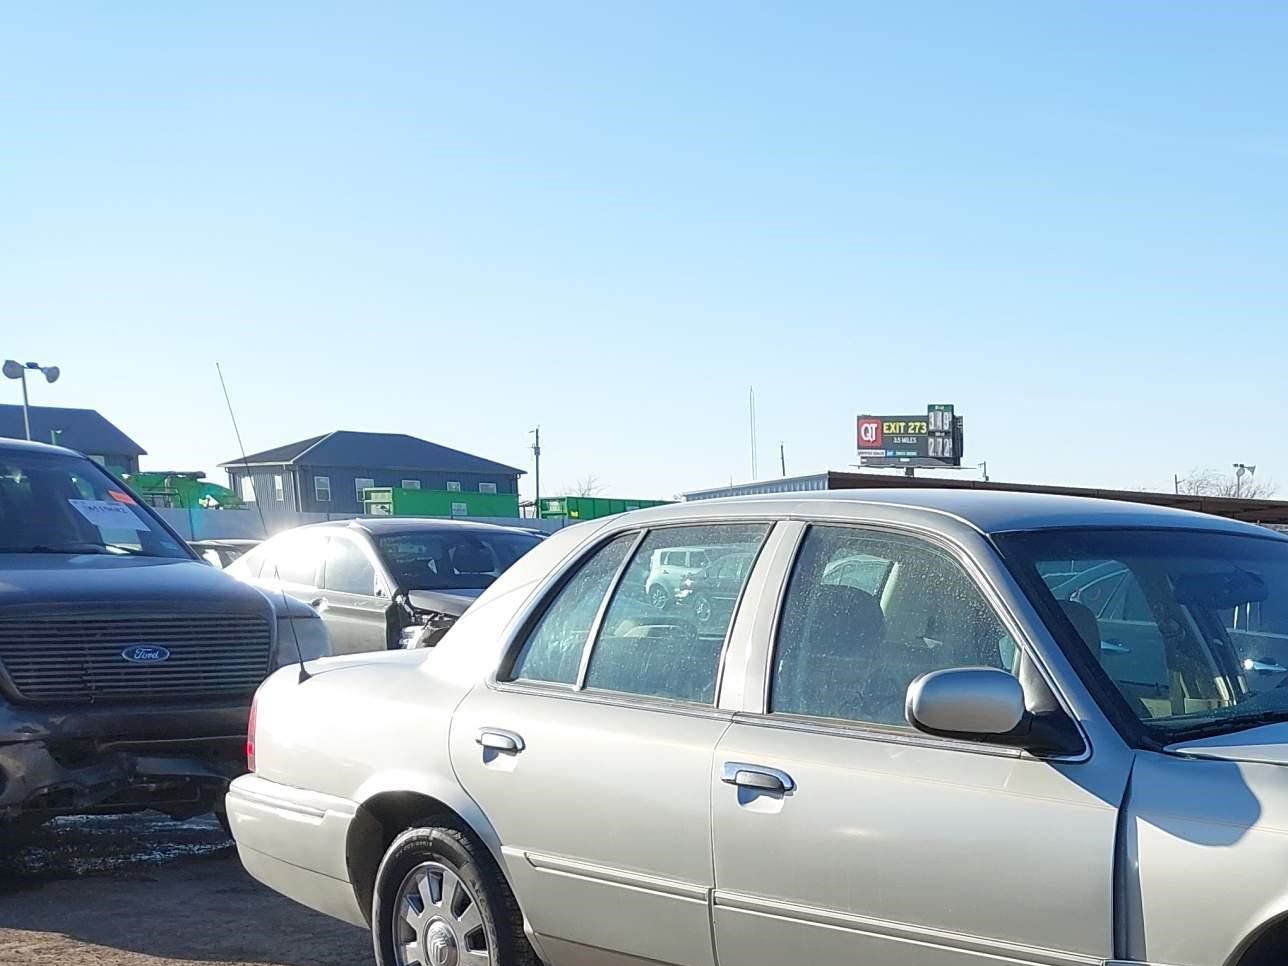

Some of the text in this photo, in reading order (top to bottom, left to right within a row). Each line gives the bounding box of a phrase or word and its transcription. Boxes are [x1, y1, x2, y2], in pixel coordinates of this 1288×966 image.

[861, 423, 878, 443] QT
[883, 422, 906, 434] EXIT
[907, 422, 927, 434] 273
[133, 648, 160, 660] Ford
